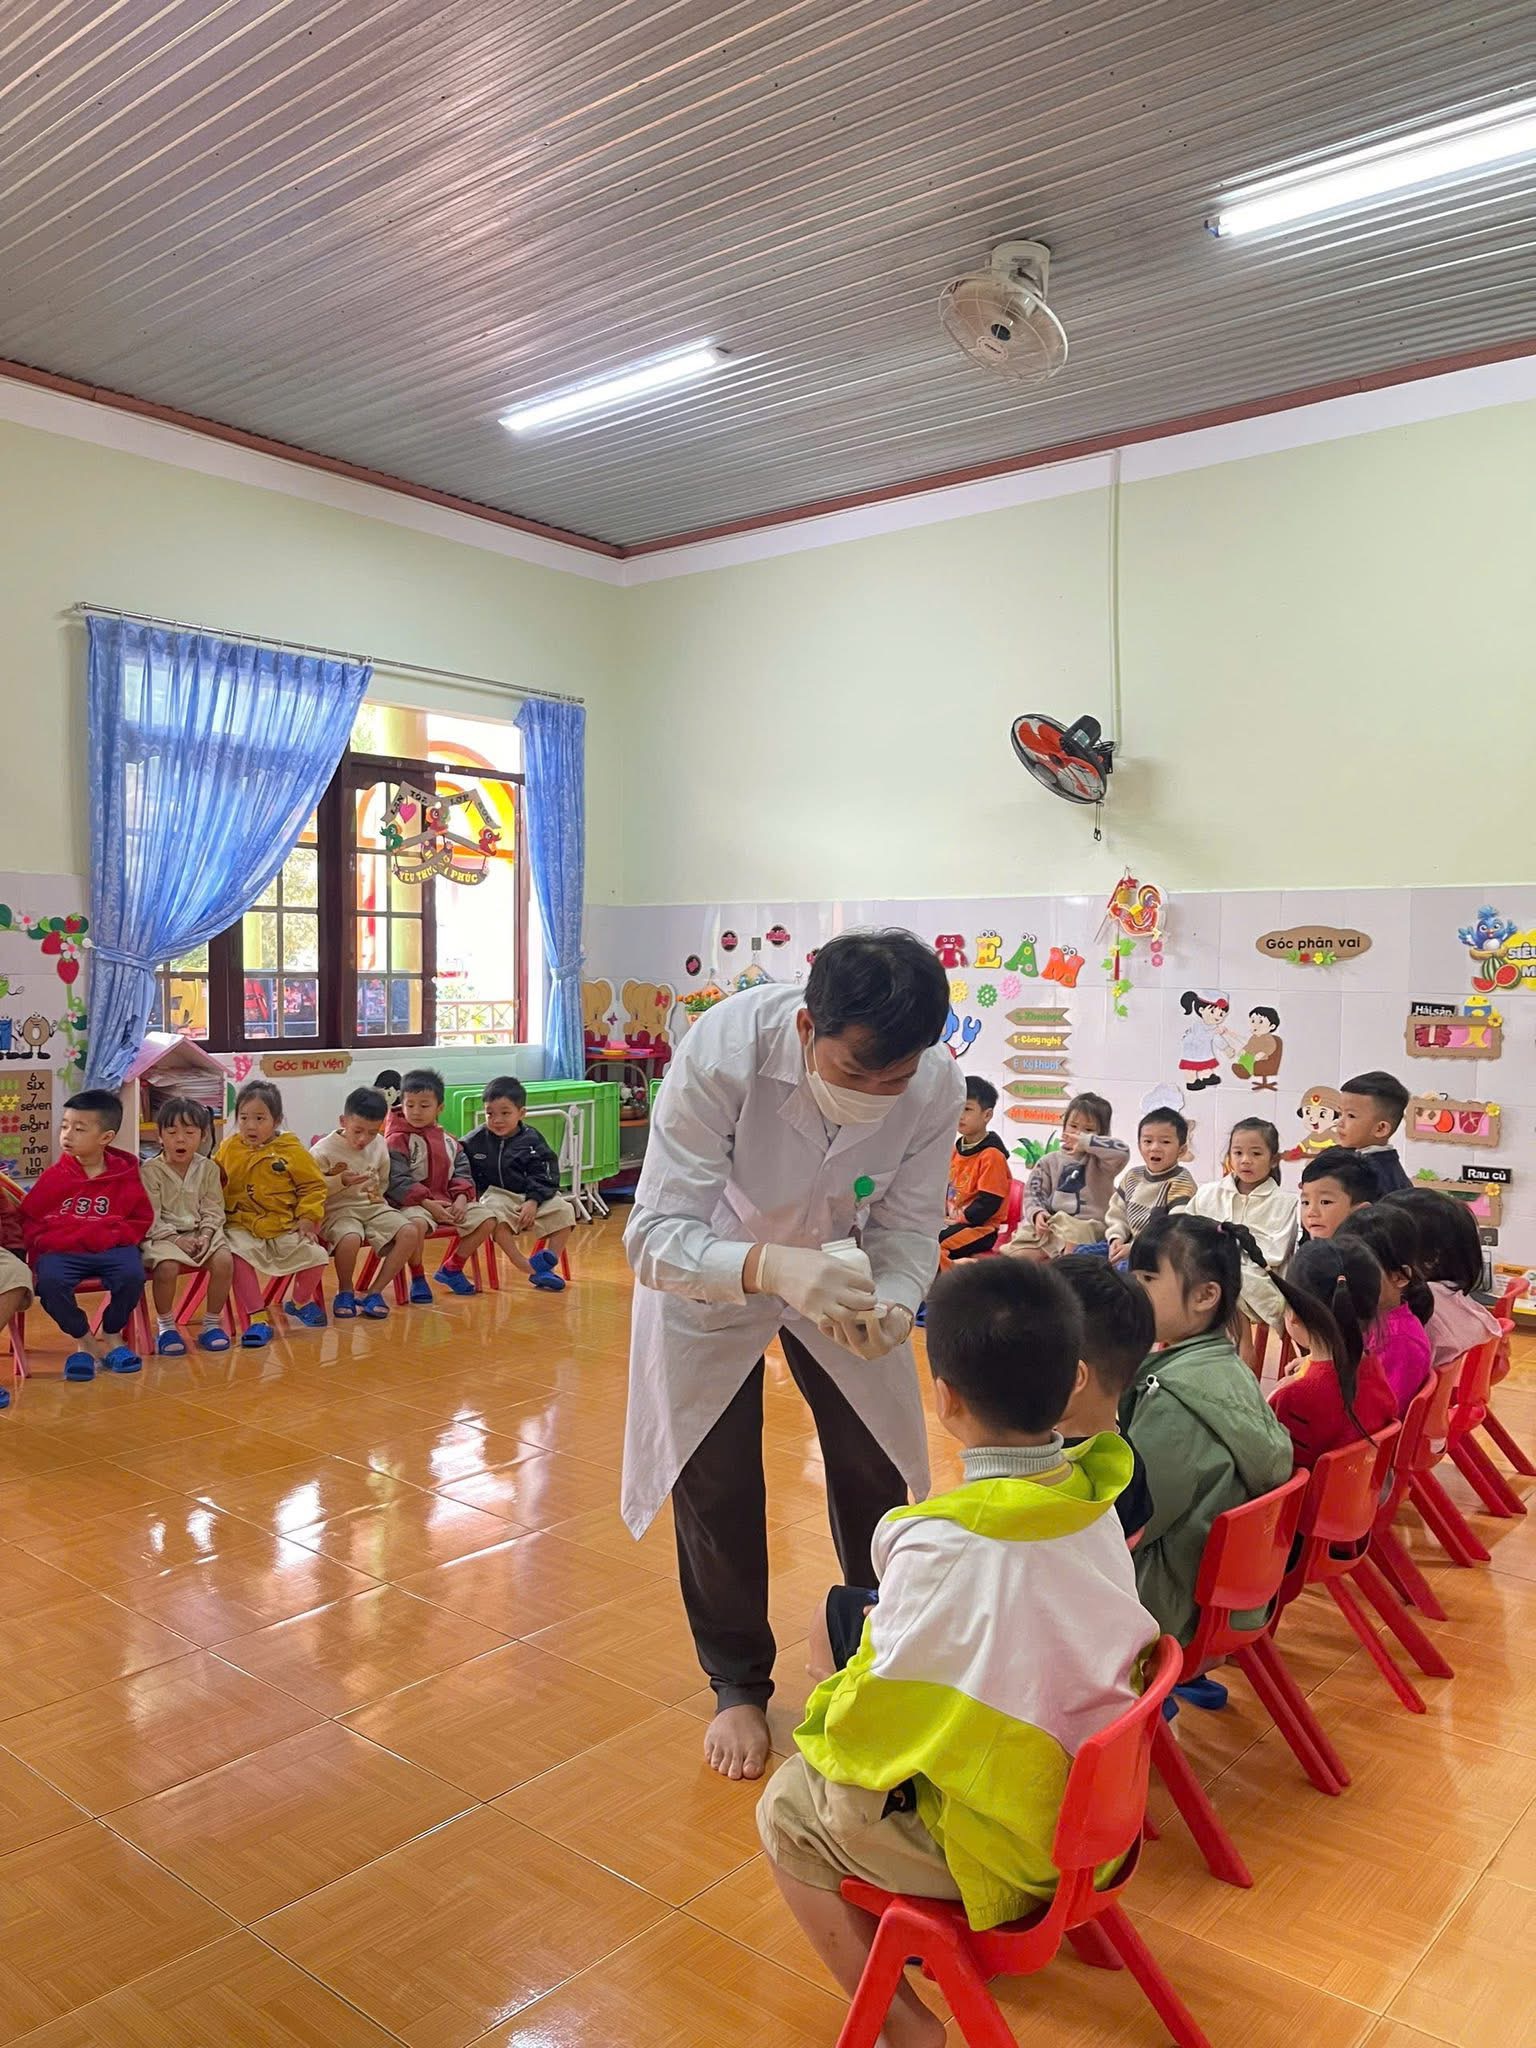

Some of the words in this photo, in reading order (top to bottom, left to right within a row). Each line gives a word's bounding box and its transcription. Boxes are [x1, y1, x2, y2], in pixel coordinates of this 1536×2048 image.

[1266, 937, 1294, 949] Góc
[1297, 936, 1333, 950] phân
[1338, 936, 1361, 948] vai
[273, 1060, 298, 1071] Góc
[302, 1059, 320, 1070] thư
[322, 1058, 344, 1071] viện
[30, 1072, 37, 1081] 6
[26, 1080, 45, 1091] six
[31, 1093, 37, 1103] 7
[20, 1101, 52, 1111] seven
[29, 1114, 36, 1124] 8
[20, 1121, 50, 1134] eight
[29, 1136, 36, 1146] 9
[22, 1145, 49, 1155] nine
[29, 1157, 41, 1167] 10
[1467, 1168, 1490, 1179] Rau
